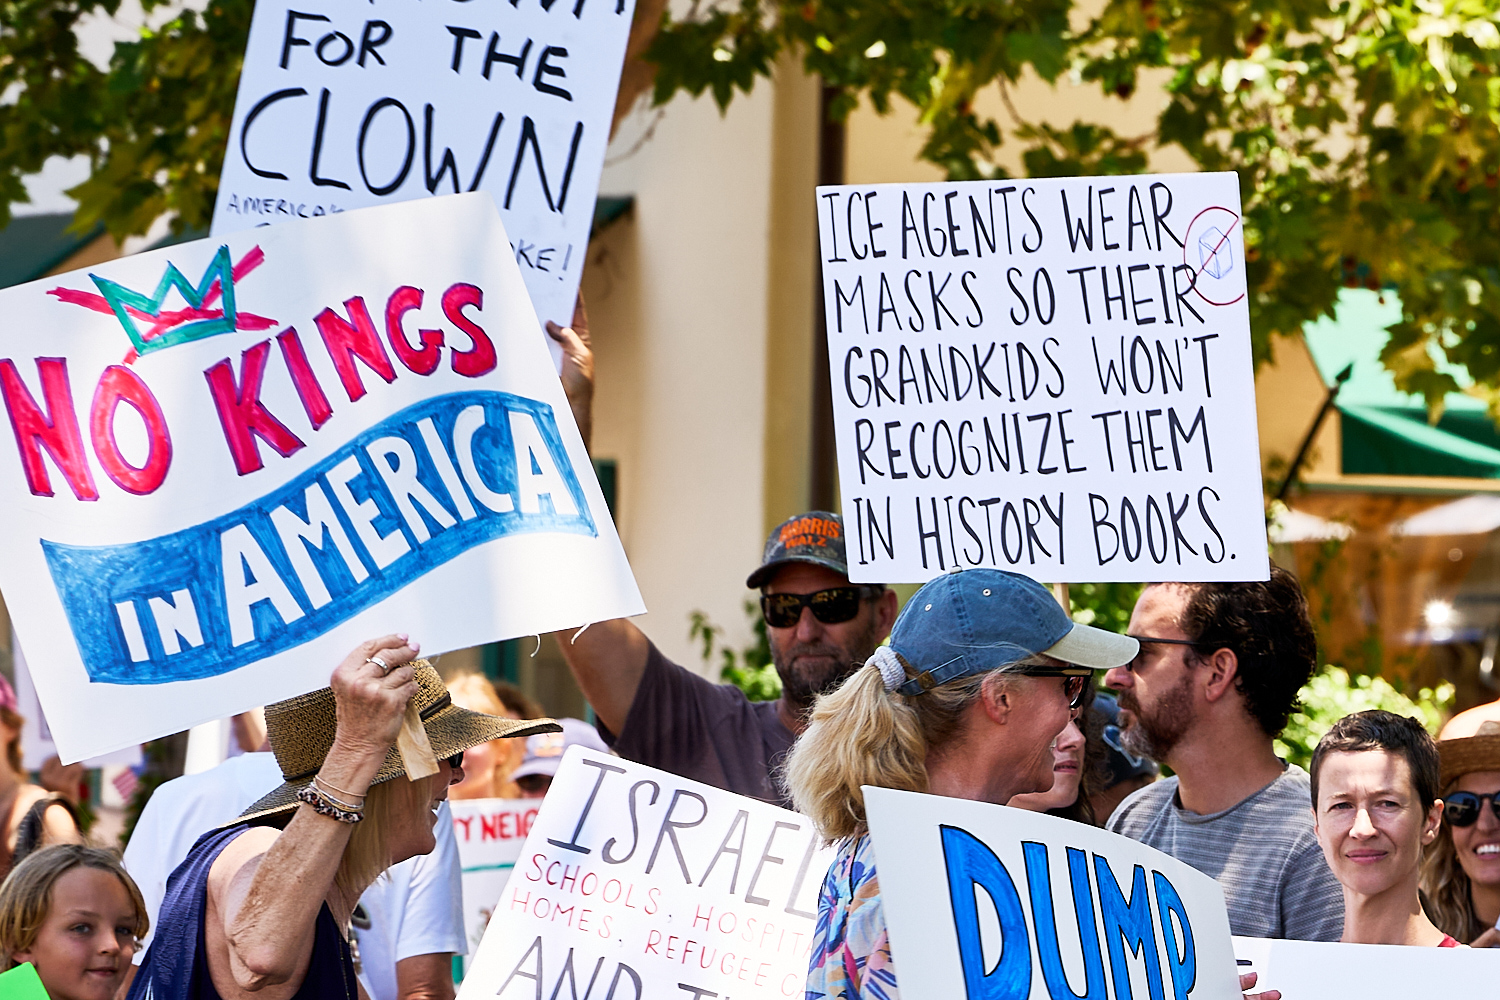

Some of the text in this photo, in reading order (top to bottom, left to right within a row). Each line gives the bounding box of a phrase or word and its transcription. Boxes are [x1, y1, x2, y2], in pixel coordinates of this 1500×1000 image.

[279, 9, 573, 101] FOR THE
[240, 87, 583, 214] CLOWN
[509, 239, 573, 281] KE!
[822, 182, 1185, 262] ICE AGENTS WEAR
[834, 264, 1205, 334] MASKS SO THEIR
[0, 282, 499, 502] NO KINGS
[844, 334, 1219, 408] GRANDKIDS WON'T
[855, 405, 1214, 484] RECOGNIZE THEM
[115, 403, 577, 663] IN AMERICA
[779, 517, 841, 542] HARRIS
[853, 486, 1237, 570] IN HISTORY BOOKS.
[453, 814, 474, 842] Y
[547, 758, 819, 922] ISRAEL
[644, 929, 772, 987] REFUGEE
